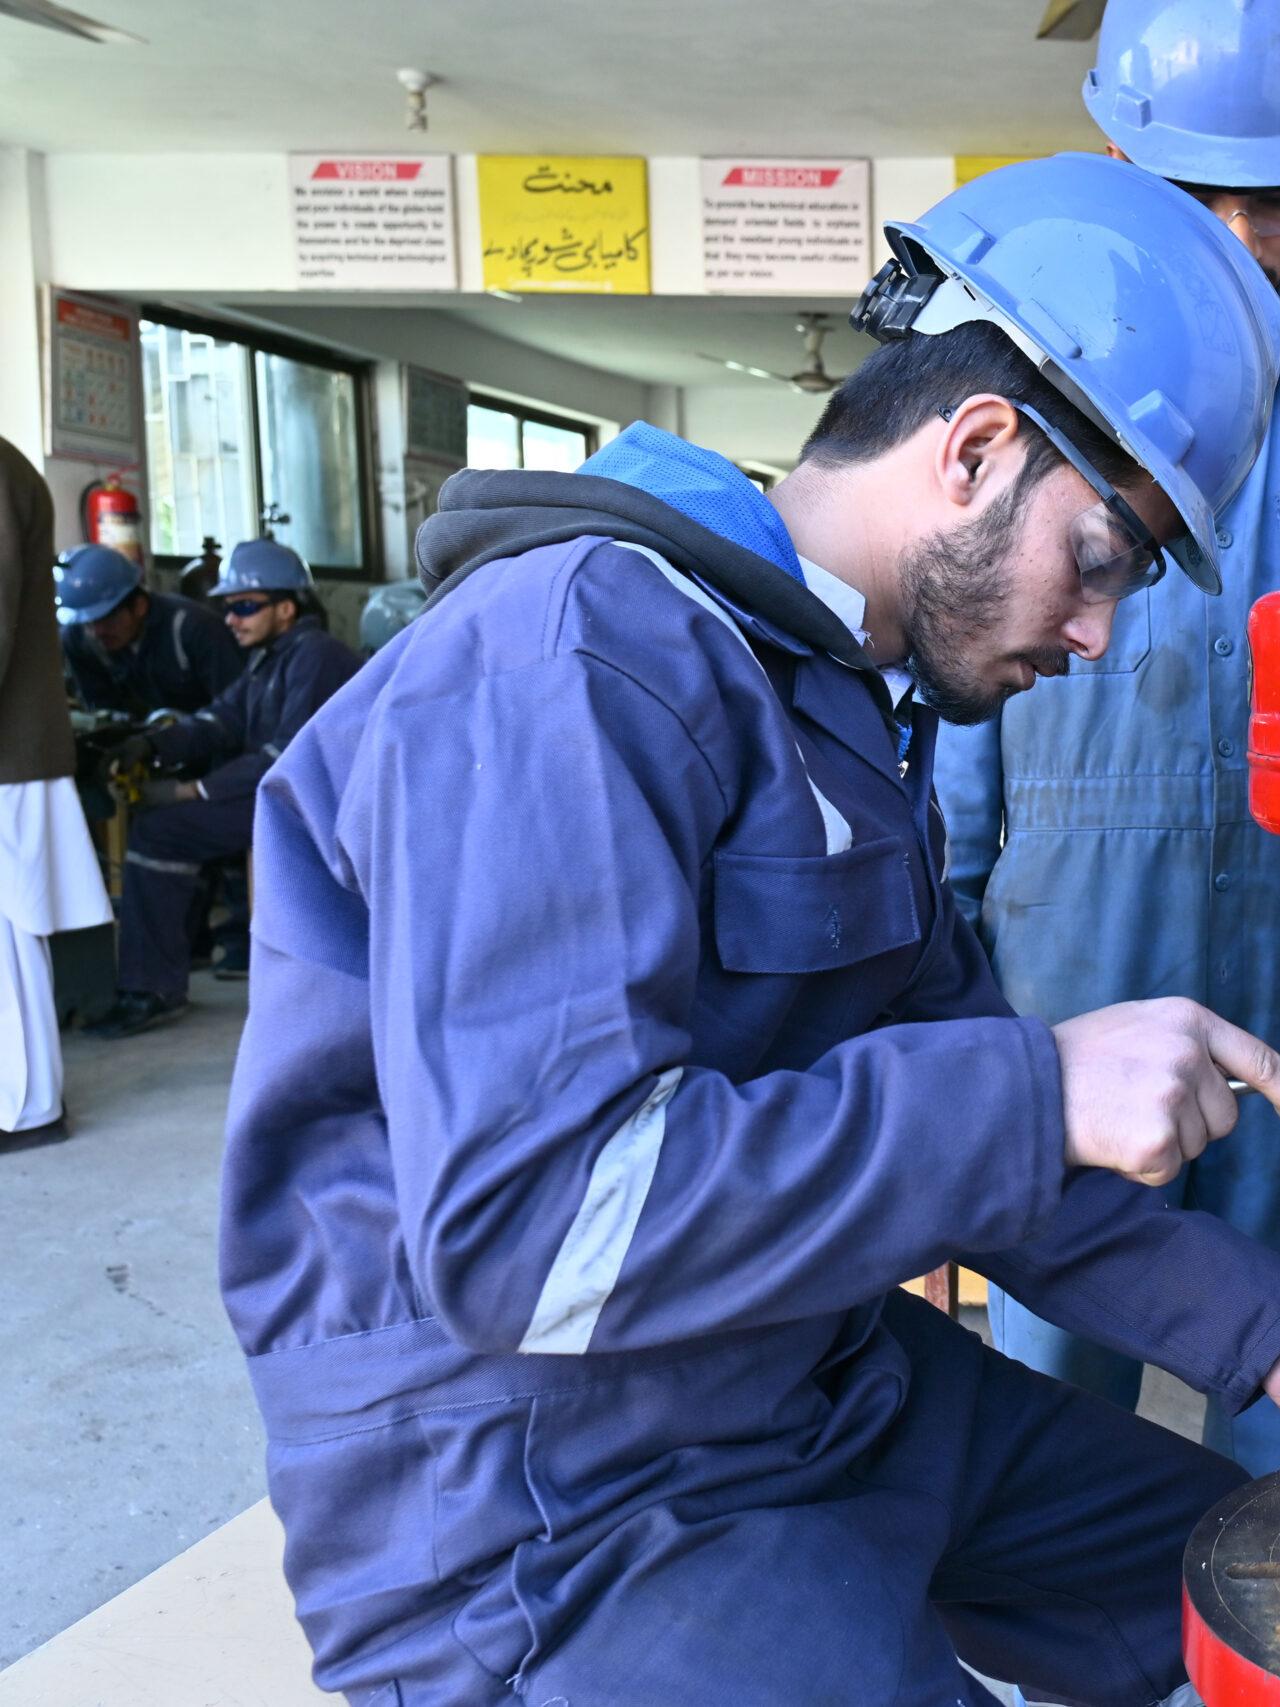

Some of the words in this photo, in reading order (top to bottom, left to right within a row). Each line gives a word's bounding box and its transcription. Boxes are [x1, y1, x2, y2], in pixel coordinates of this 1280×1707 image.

[336, 163, 397, 179] VISION
[523, 166, 613, 194] محنت
[742, 169, 821, 186] MISSION
[554, 227, 649, 272] کامیابی
